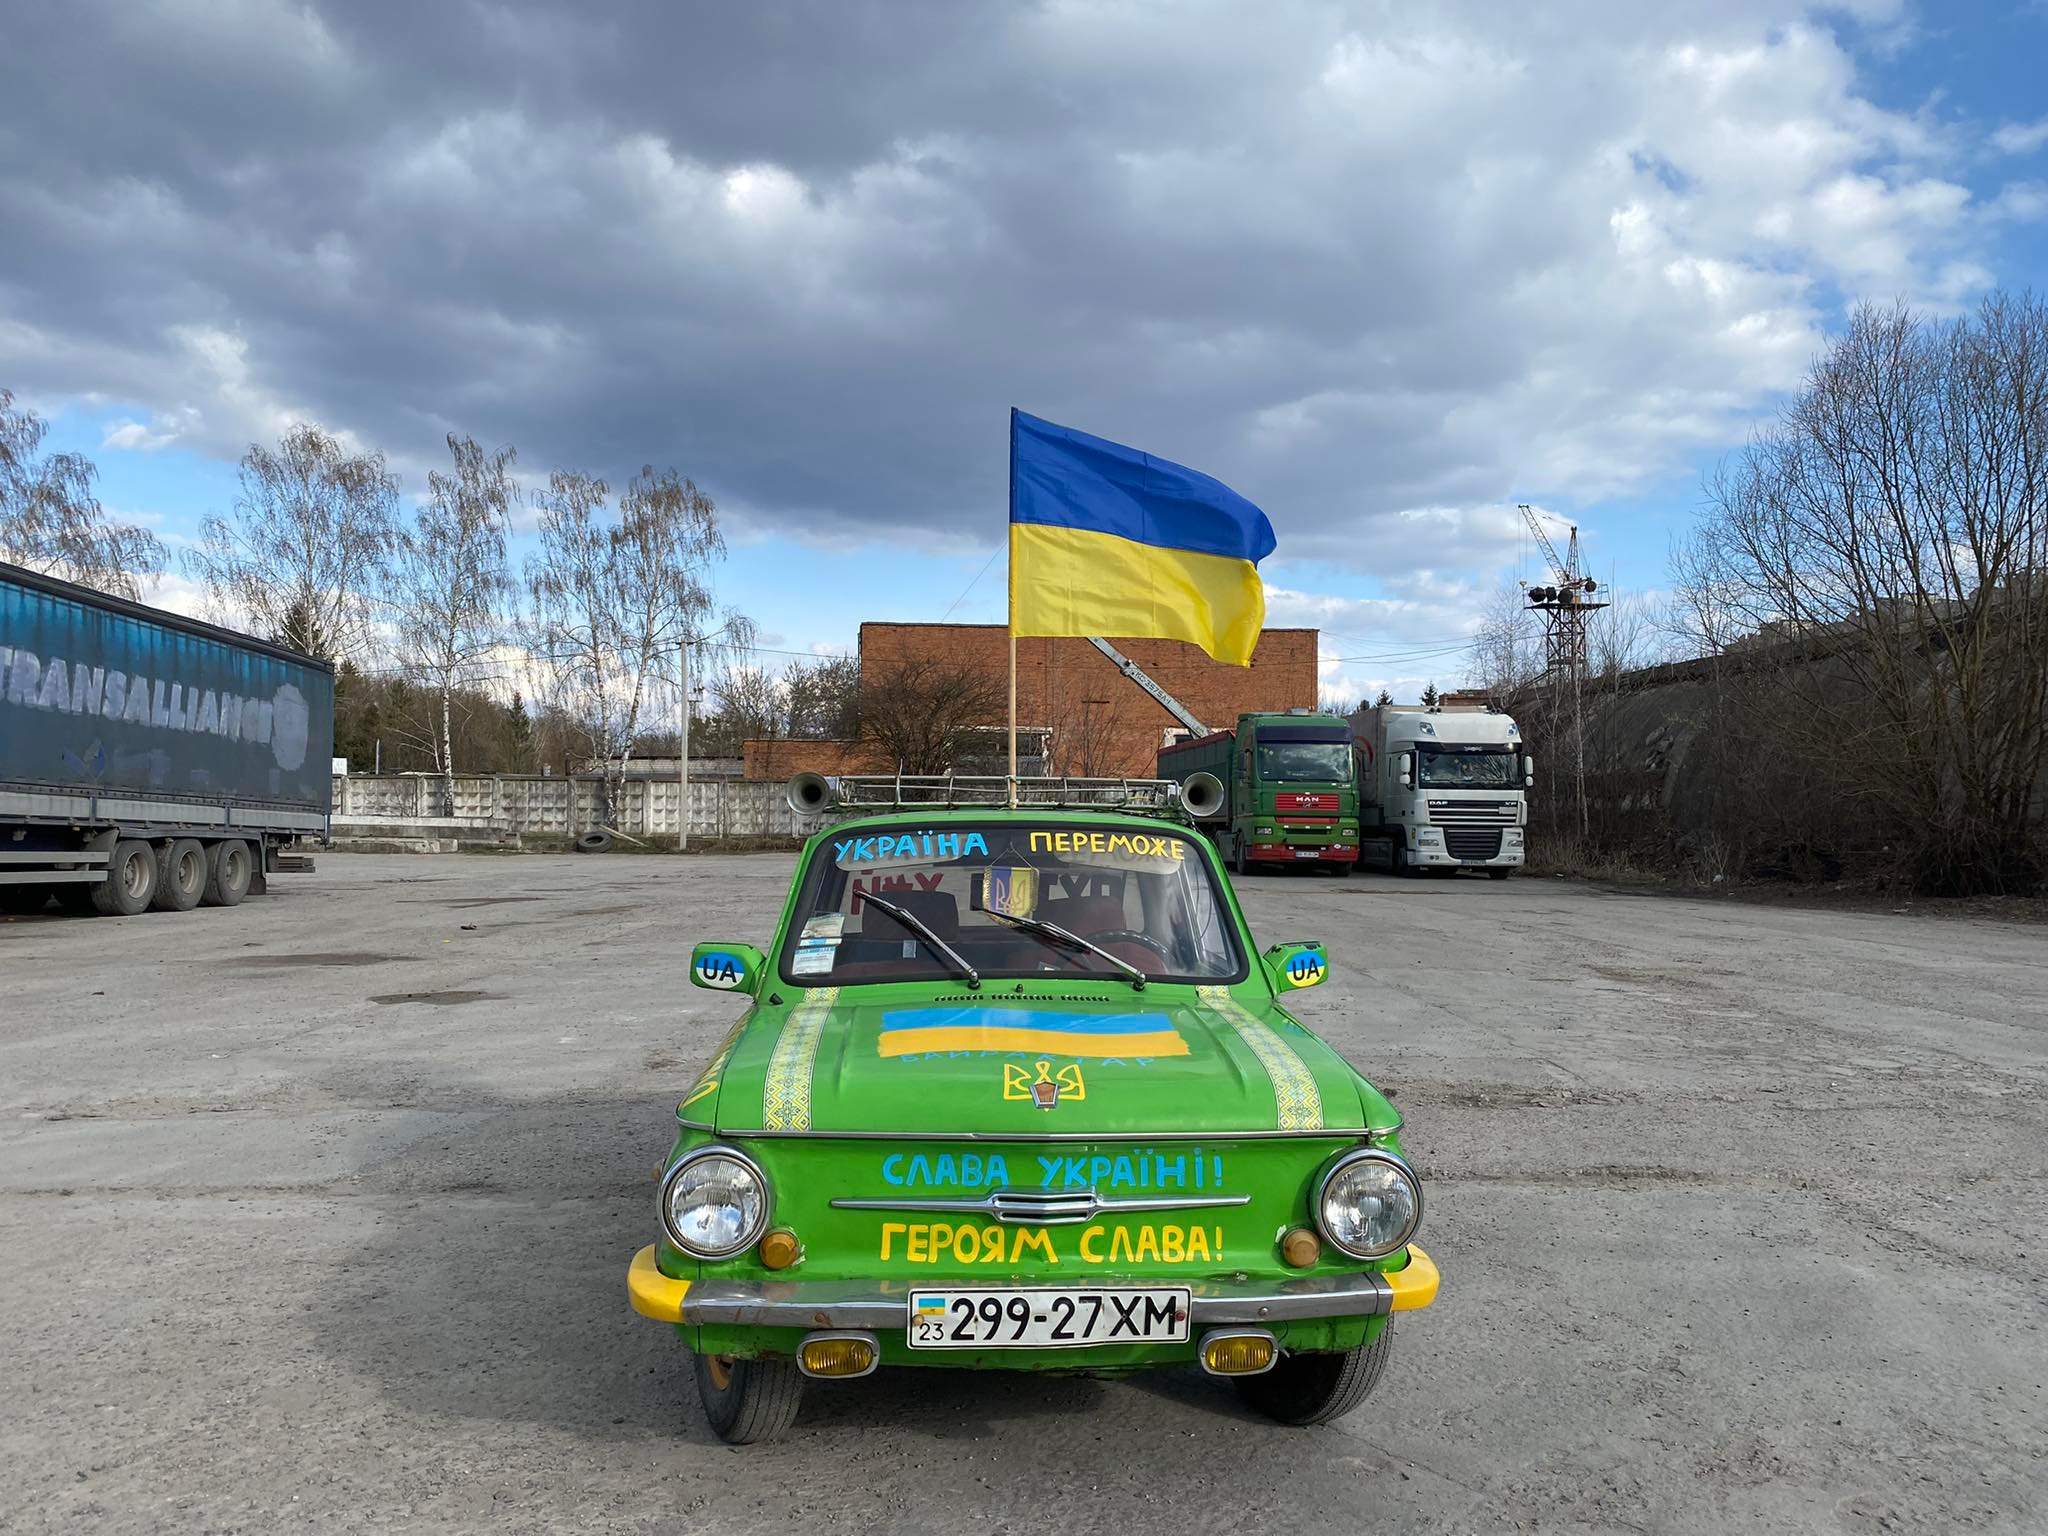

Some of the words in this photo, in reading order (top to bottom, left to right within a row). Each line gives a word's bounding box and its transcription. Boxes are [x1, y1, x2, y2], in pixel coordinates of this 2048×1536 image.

[833, 830, 989, 862] УКРАЇНА
[1030, 831, 1185, 860] ПЕРЕМОЖЕ
[703, 957, 737, 983] UA
[1292, 957, 1320, 981] UA
[882, 1153, 1009, 1187] СЛАВА
[1037, 1147, 1224, 1188] УКРАЇНІ!
[879, 1222, 1059, 1264] ГЕРОЯМ
[1079, 1225, 1224, 1264] СЛАВА!
[918, 1322, 944, 1341] 23
